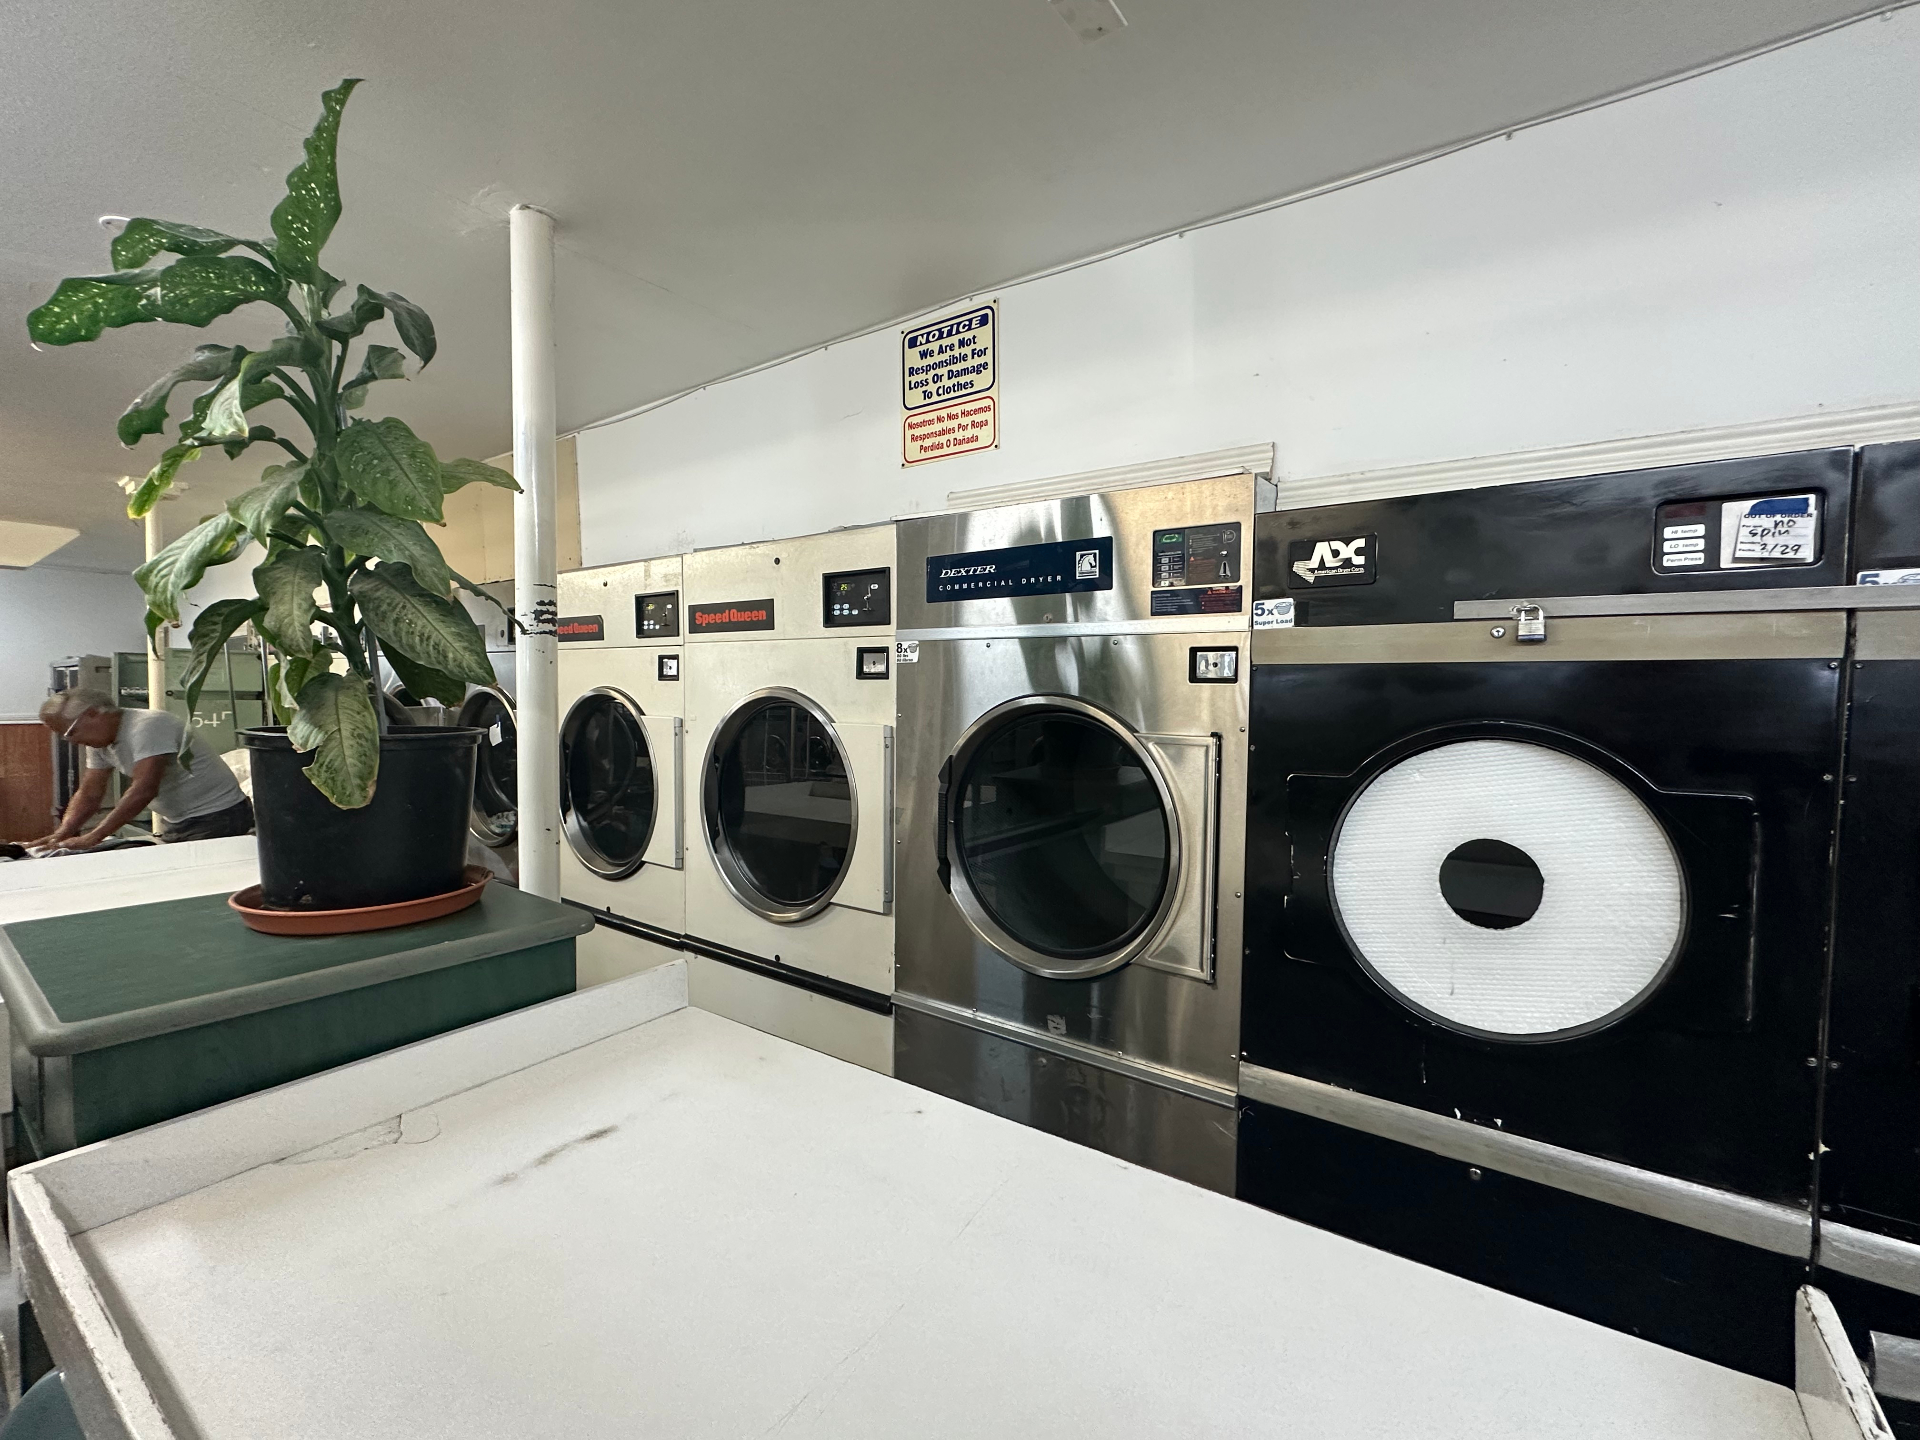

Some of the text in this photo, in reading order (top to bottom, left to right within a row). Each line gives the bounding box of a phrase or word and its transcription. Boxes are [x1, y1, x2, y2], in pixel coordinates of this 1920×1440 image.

[916, 316, 982, 346] NOTICE
[918, 335, 977, 360] We Are Not
[908, 347, 988, 377] Responsible For
[908, 361, 989, 391] Loss Or Damage
[922, 380, 974, 400] To Clothes
[907, 405, 991, 431] Nosotros No Nos Hacemos
[910, 419, 989, 443] Responsables Por Ropa
[919, 433, 979, 454] Perdida O Dañada
[939, 564, 997, 578] DEXTER
[938, 575, 1063, 592] COMMERCIAL DRYER
[695, 608, 767, 627] Speed Queen
